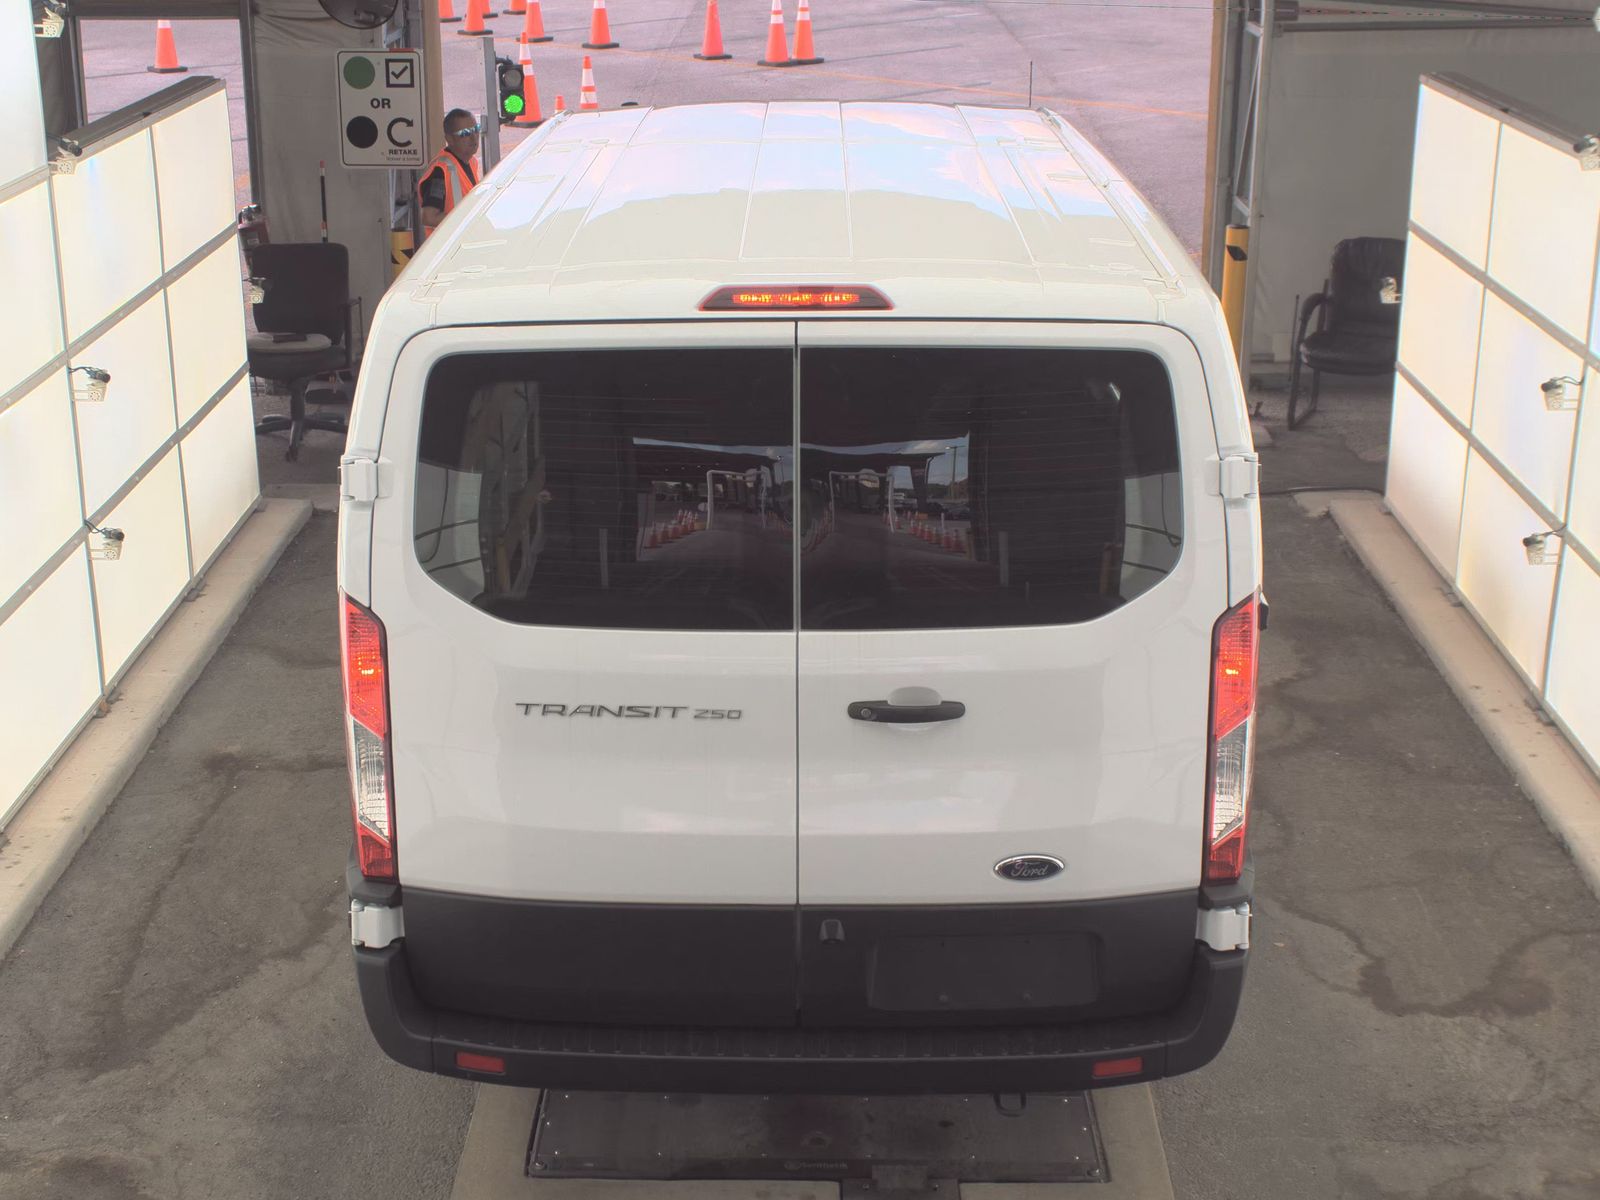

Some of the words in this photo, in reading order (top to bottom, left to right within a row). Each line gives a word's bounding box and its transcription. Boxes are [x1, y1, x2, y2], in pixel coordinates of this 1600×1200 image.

[370, 98, 391, 109] OR
[515, 703, 689, 719] TRANSIT
[694, 709, 743, 720] 250
